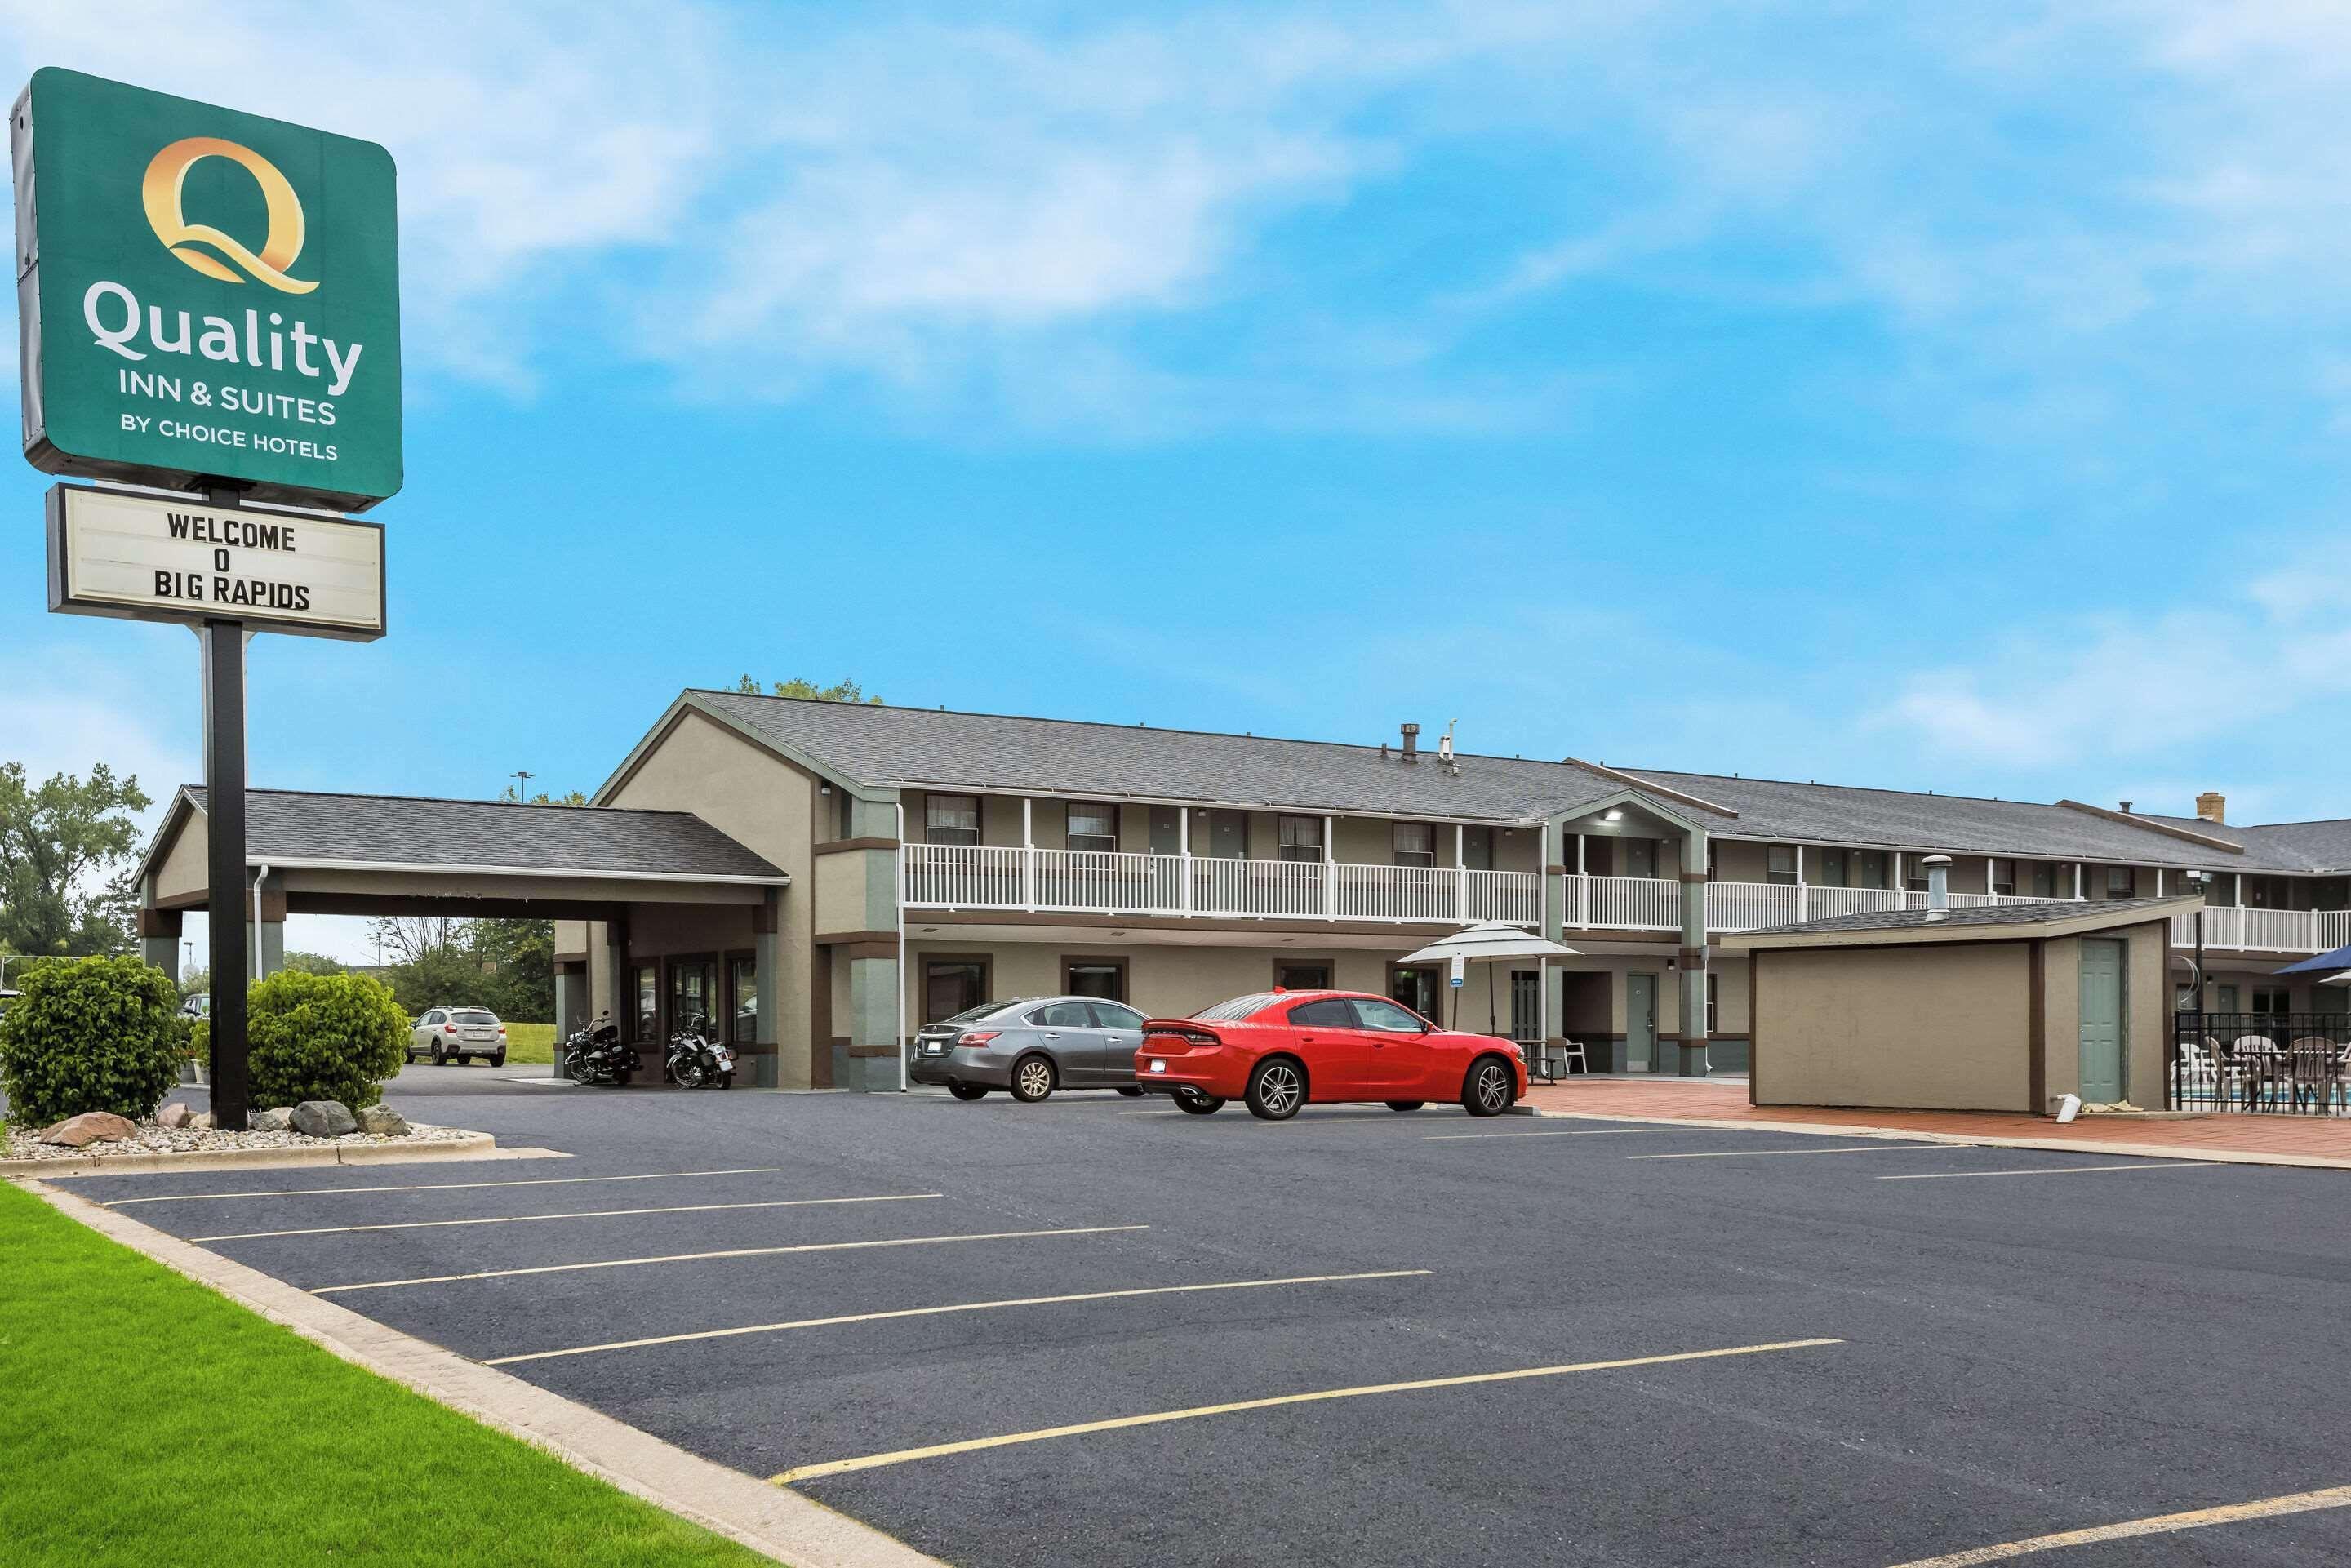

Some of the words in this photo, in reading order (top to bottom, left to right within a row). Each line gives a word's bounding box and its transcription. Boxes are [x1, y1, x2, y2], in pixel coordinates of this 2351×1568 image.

[83, 280, 363, 397] Quality
[119, 368, 181, 402] INN
[190, 381, 212, 407] &
[220, 386, 336, 426] SUITES
[121, 413, 151, 433] BY
[158, 420, 247, 448] CHOICE
[253, 433, 338, 461] HOTELS
[167, 513, 296, 552] WELCOME
[154, 570, 203, 601] BIG
[213, 576, 309, 611] RAPIDS
